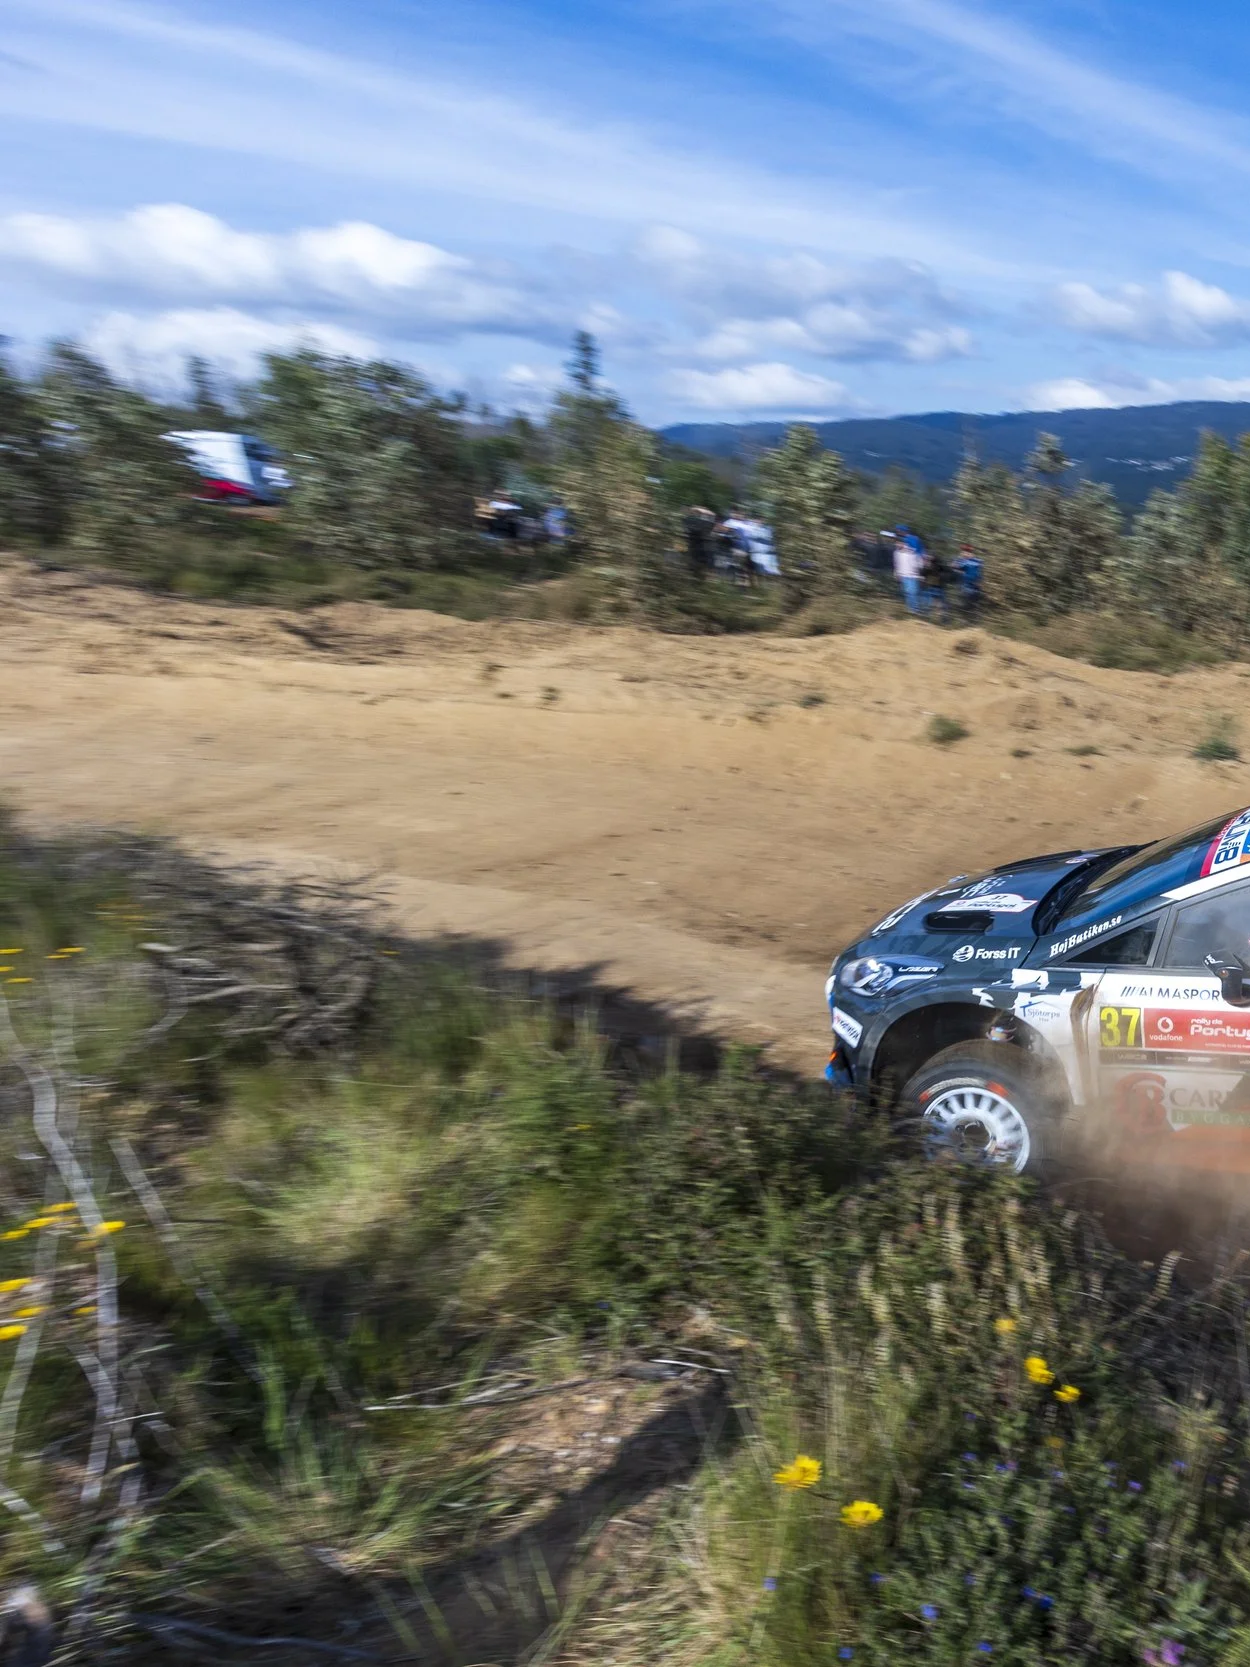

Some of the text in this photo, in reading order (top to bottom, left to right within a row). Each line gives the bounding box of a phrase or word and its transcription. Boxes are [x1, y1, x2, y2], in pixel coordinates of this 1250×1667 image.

[975, 947, 1021, 960] Forss IT
[1100, 1007, 1140, 1046] 37
[1191, 1018, 1210, 1026] rally
[1150, 1033, 1183, 1042] vodafone
